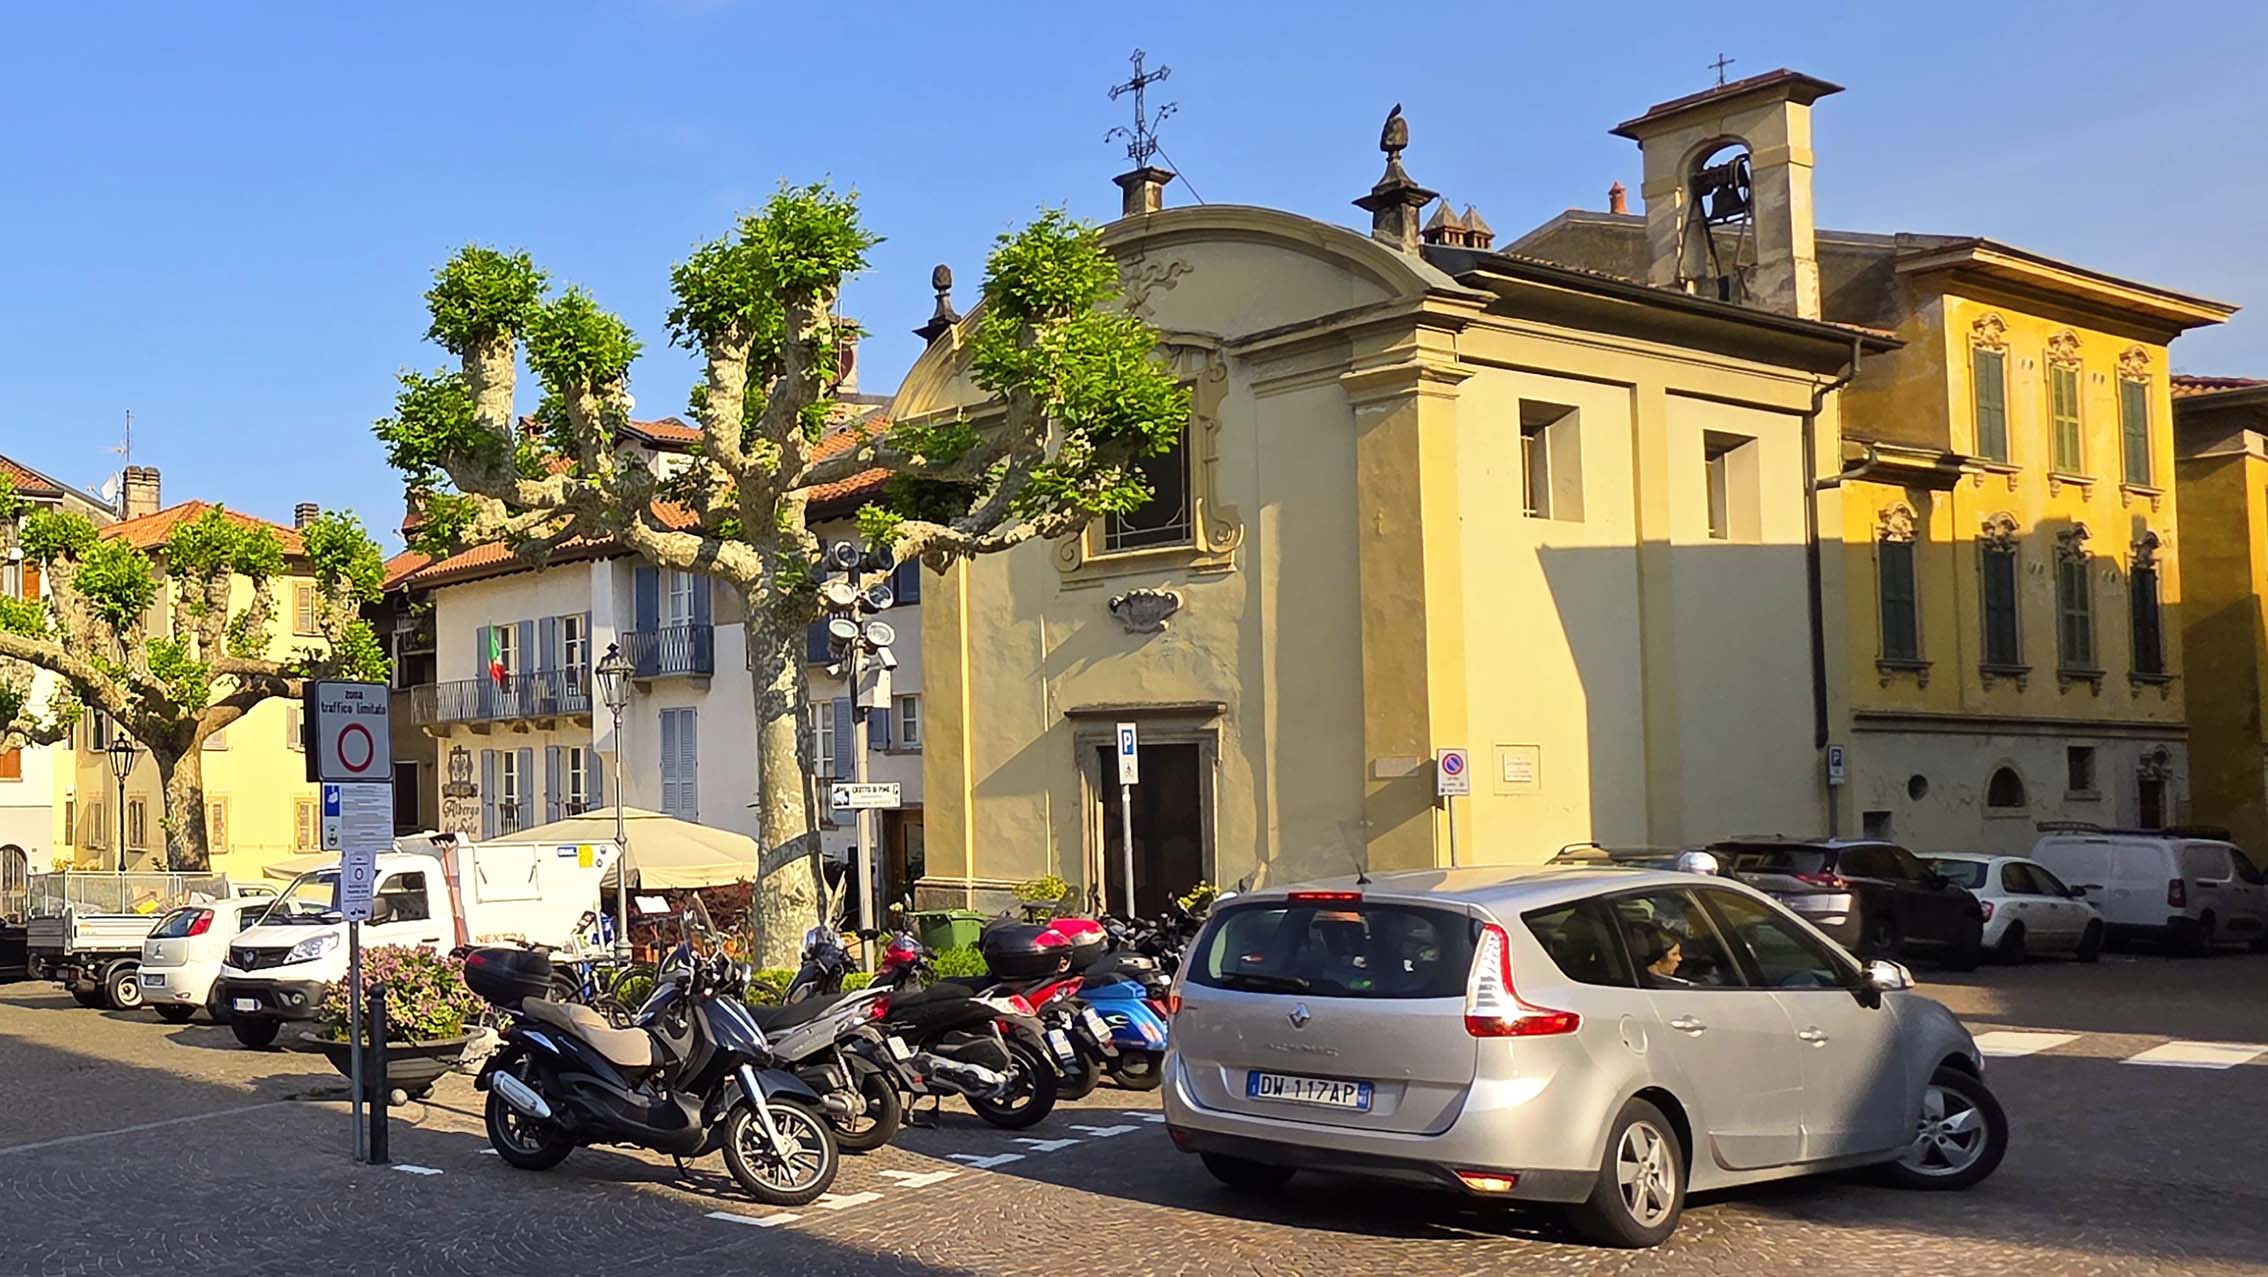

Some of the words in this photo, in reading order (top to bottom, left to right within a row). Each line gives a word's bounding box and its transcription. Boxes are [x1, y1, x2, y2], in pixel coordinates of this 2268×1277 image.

[345, 690, 364, 700] zona
[321, 701, 353, 714] traffico
[1123, 732, 1132, 753] P
[442, 799, 480, 819] Albergo
[1260, 1076, 1285, 1095] DW
[1295, 1079, 1356, 1103] 117AP
